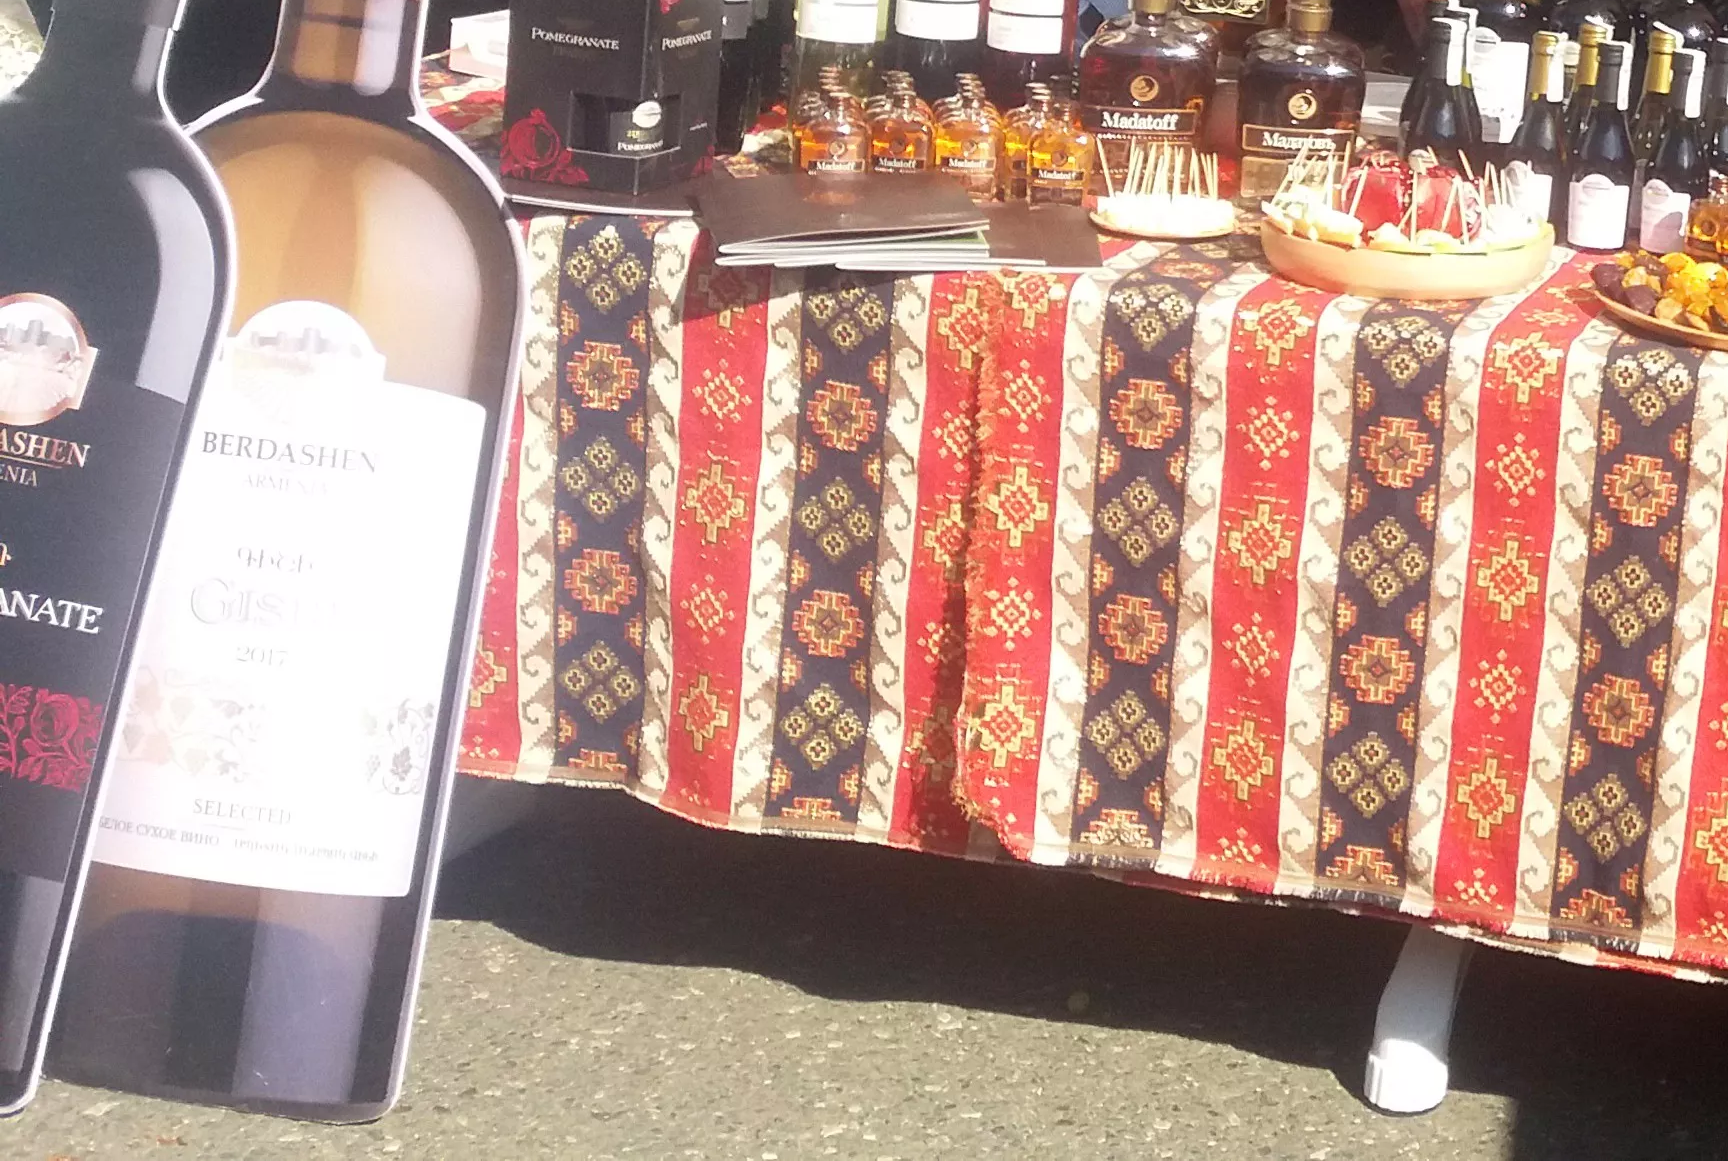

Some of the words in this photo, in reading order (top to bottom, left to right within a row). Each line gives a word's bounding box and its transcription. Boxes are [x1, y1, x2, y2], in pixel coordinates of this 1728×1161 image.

[531, 26, 620, 51] POMEGRANATE
[661, 29, 713, 51] POMEGRANATE
[1100, 111, 1179, 131] Madatoff
[816, 160, 857, 172] Madatoff
[878, 157, 917, 169] Madatoff
[948, 157, 988, 169] Madatoff
[1038, 169, 1077, 181] Madatoff
[202, 430, 380, 473] BERDASHEN
[190, 577, 338, 627] GIS
[235, 644, 289, 667] 2017
[193, 797, 292, 825] SELECTED
[136, 822, 178, 841] СУХОЕ
[180, 831, 220, 848] ВИНО
